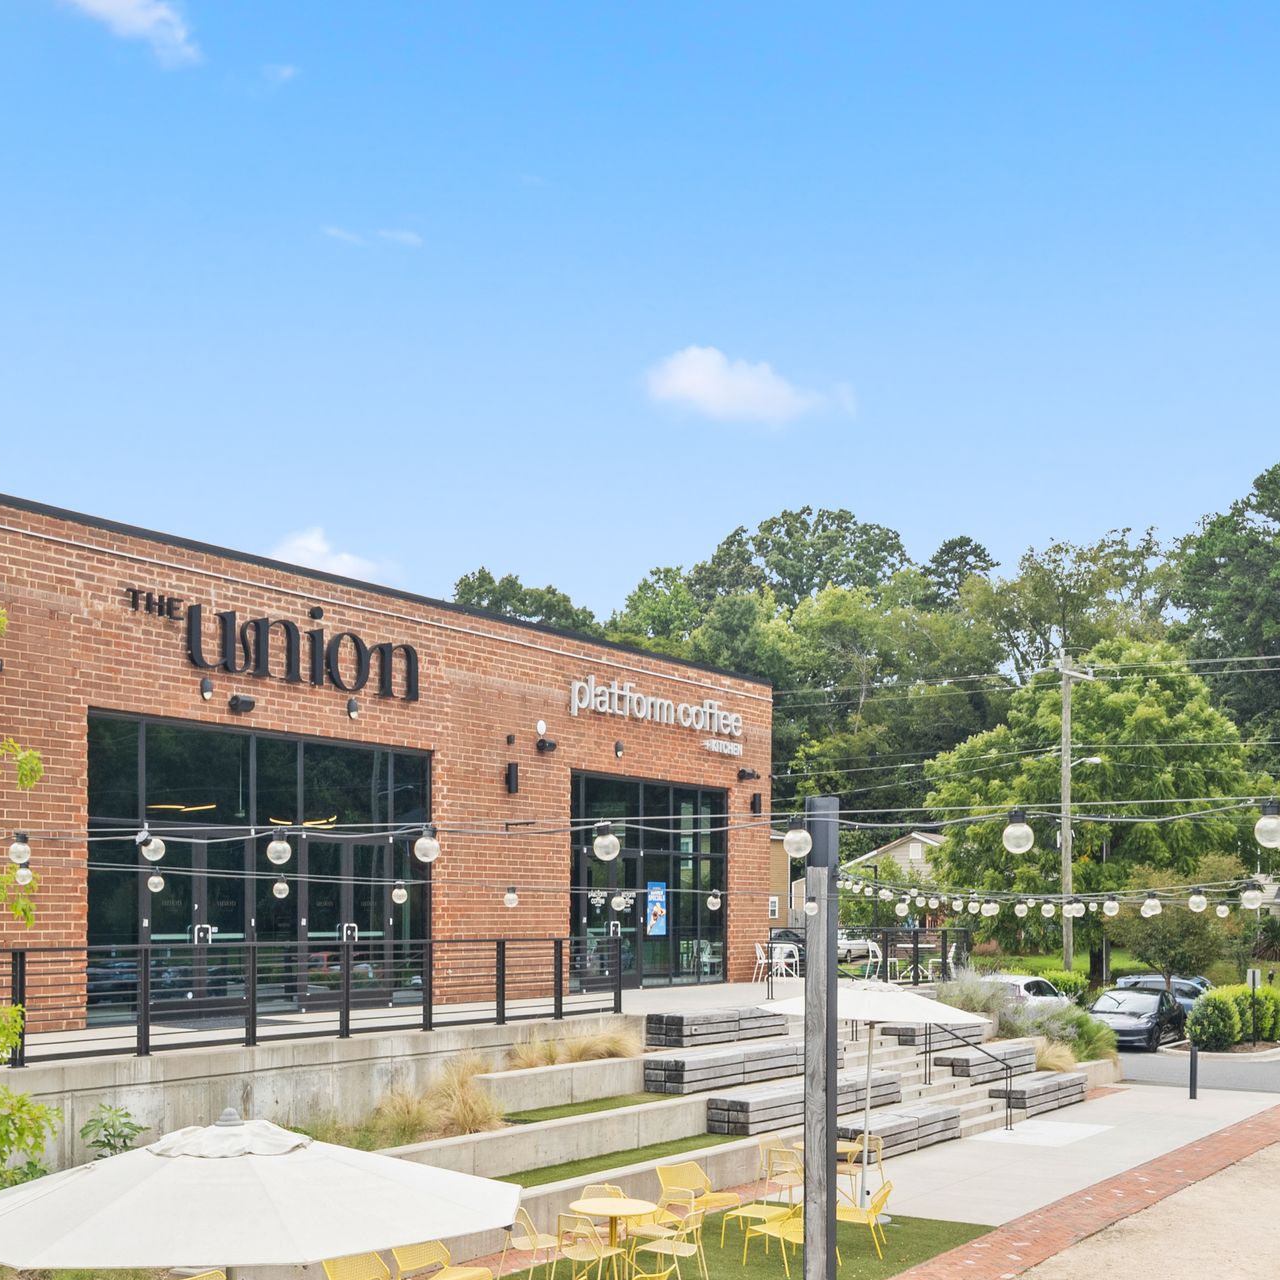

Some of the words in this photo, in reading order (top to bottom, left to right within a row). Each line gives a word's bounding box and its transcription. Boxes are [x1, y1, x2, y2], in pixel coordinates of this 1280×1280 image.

[124, 587, 184, 621] THE
[570, 674, 675, 724] platform
[676, 699, 743, 737] coffee
